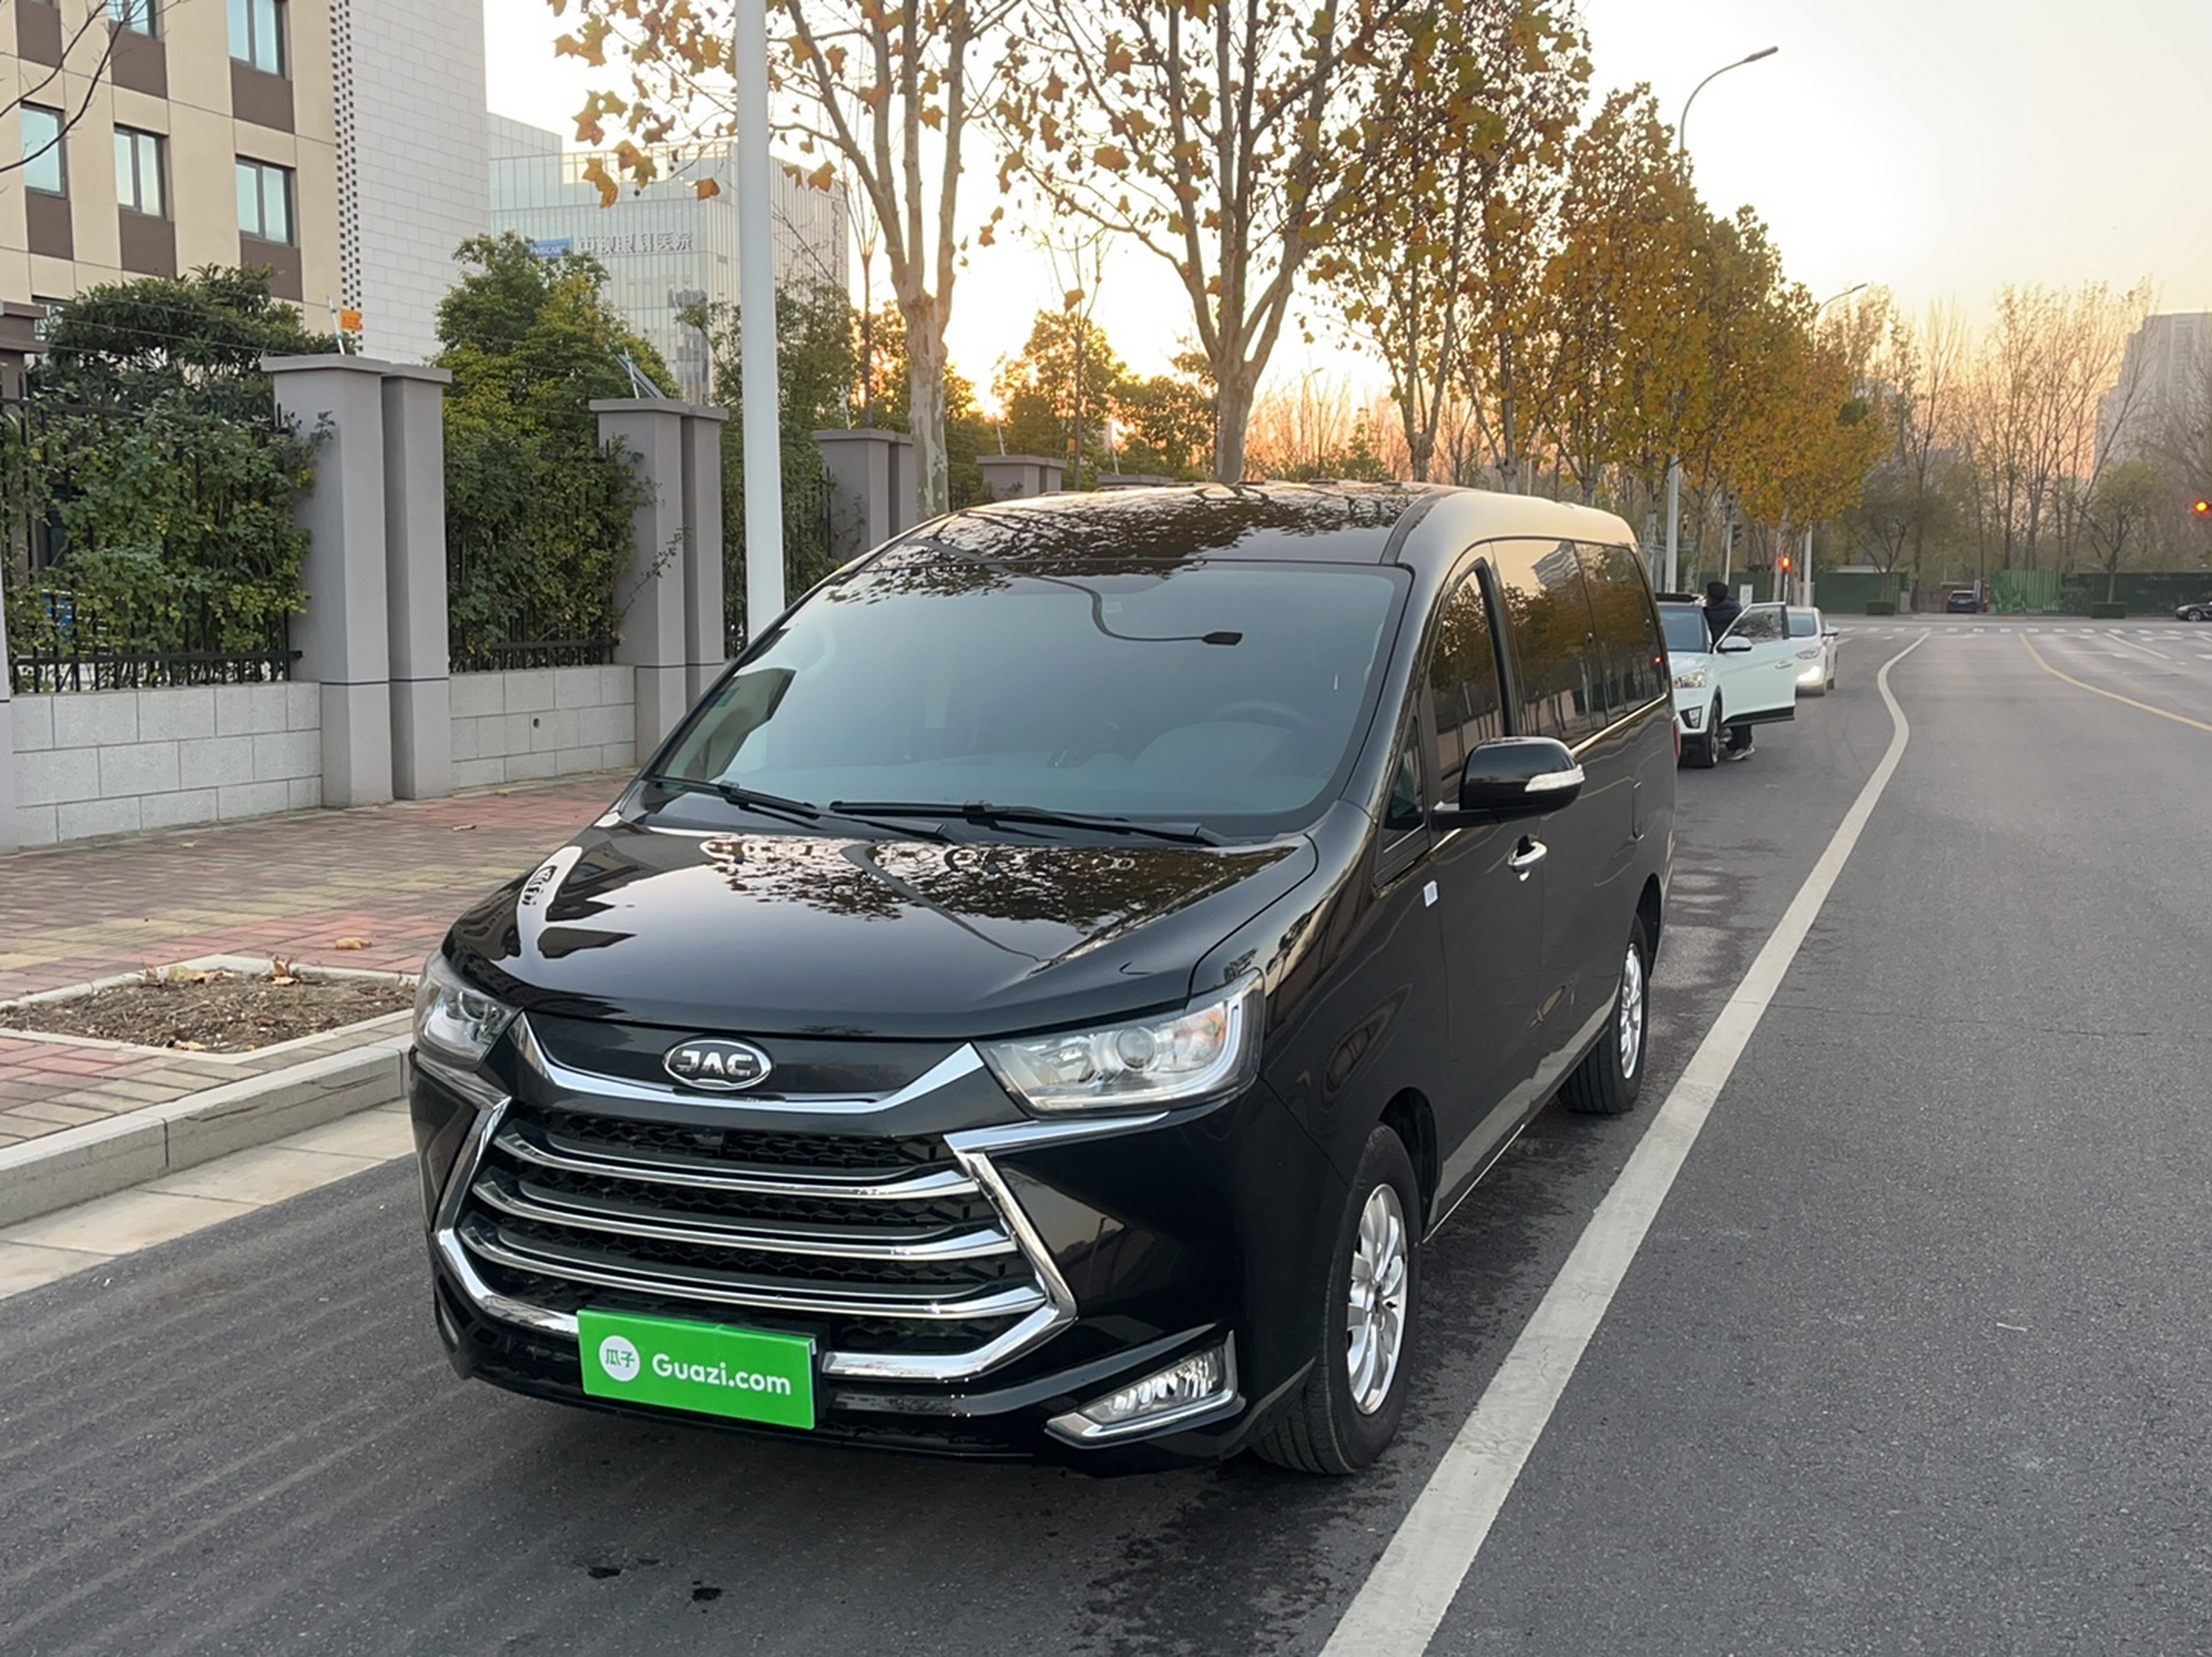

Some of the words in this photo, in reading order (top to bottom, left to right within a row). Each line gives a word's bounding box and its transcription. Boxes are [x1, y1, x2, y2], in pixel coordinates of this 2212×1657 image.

[676, 1050, 753, 1076] JAC
[605, 1349, 635, 1368] 瓜子
[652, 1353, 791, 1395] Guazi.com
